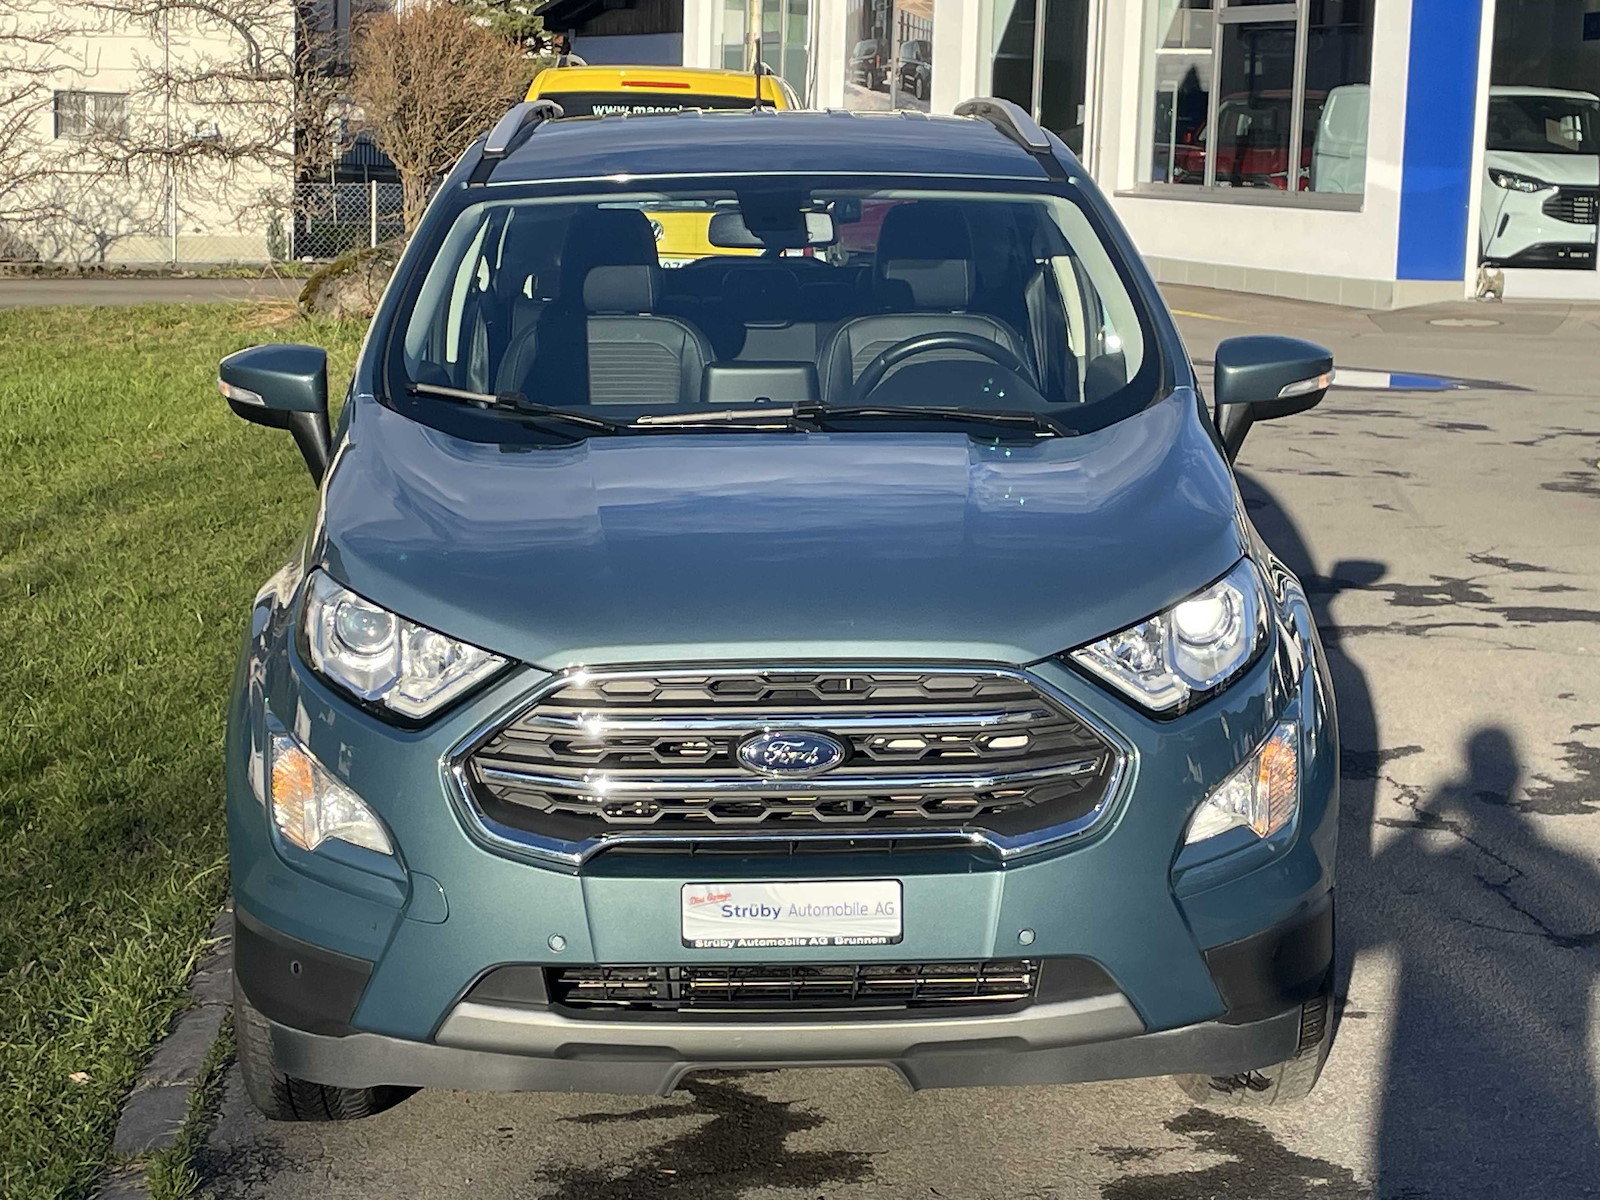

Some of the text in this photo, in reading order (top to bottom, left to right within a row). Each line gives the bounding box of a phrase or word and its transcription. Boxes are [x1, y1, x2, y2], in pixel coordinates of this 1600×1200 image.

[764, 741, 819, 764] Ford
[721, 902, 895, 920] Strüby Automobile AG
[695, 936, 887, 948] Strüby Automobile AG Brunnen
